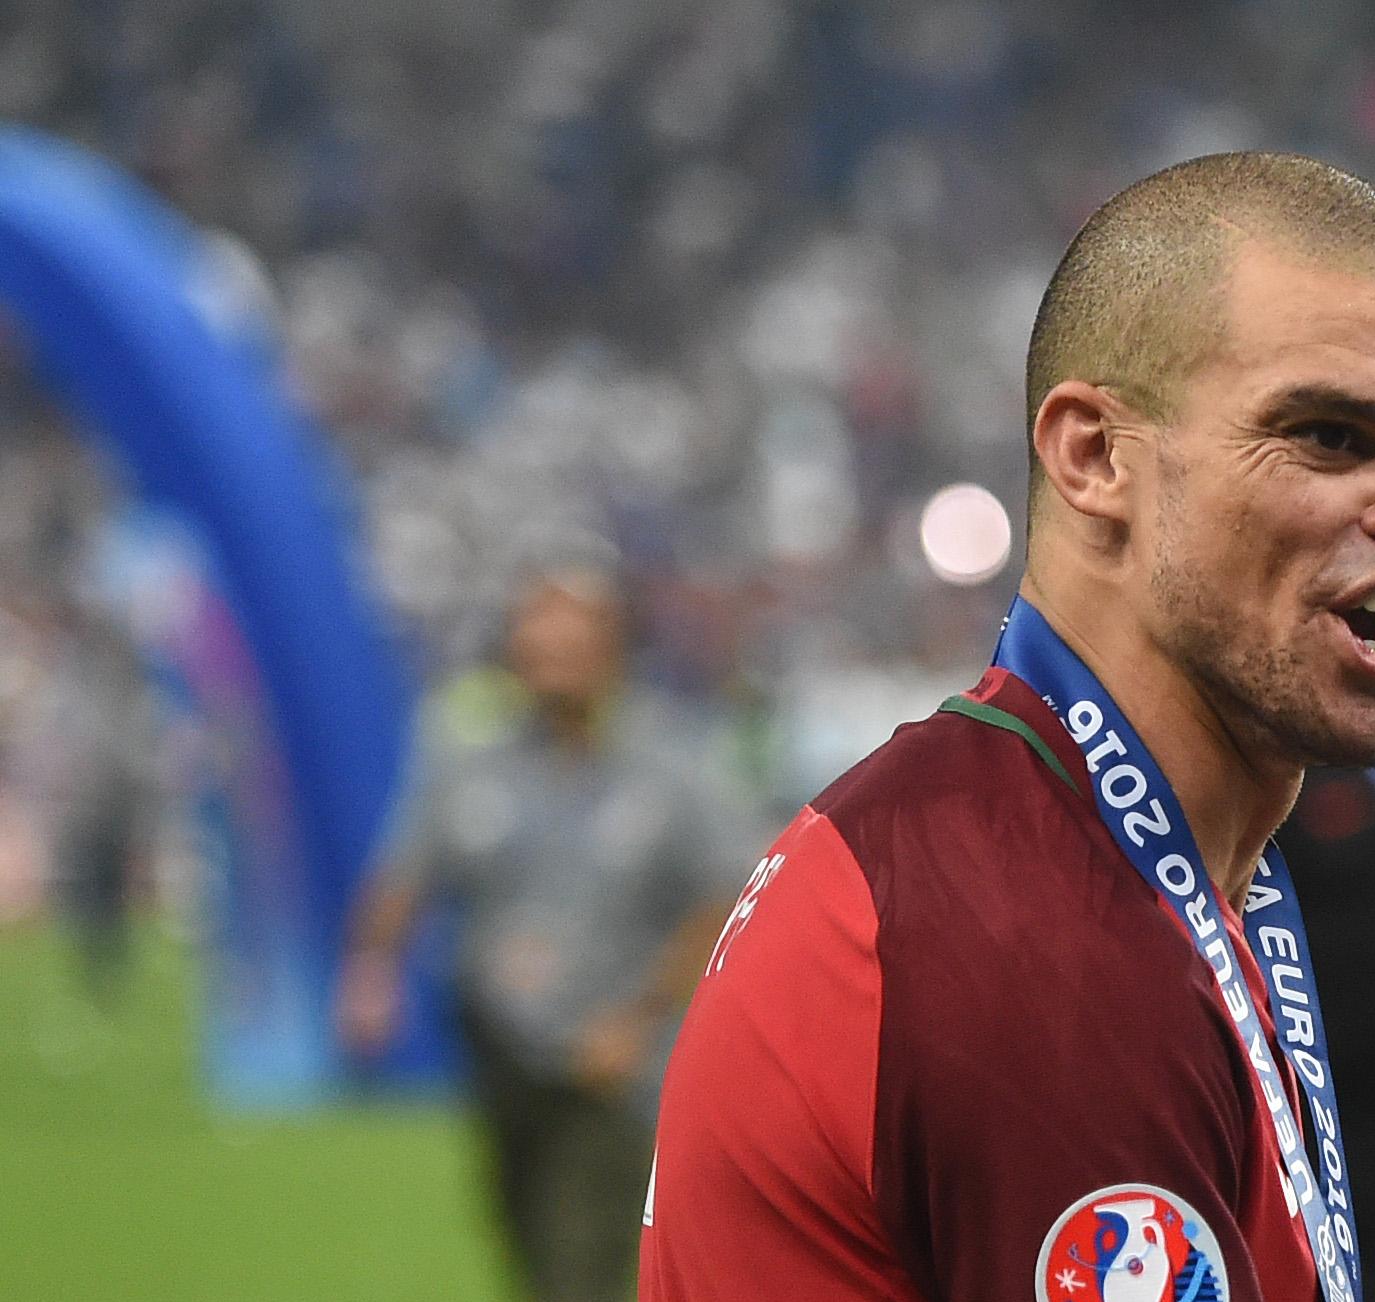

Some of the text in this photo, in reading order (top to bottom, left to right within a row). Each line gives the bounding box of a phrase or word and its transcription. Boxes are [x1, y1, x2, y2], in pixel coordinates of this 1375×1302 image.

[1059, 701, 1171, 848] 2016
[1156, 854, 1248, 1022] EURO
[1250, 1032, 1313, 1205] UEFA
[1257, 925, 1325, 1089] EURO
[1313, 1096, 1356, 1256] 2016
